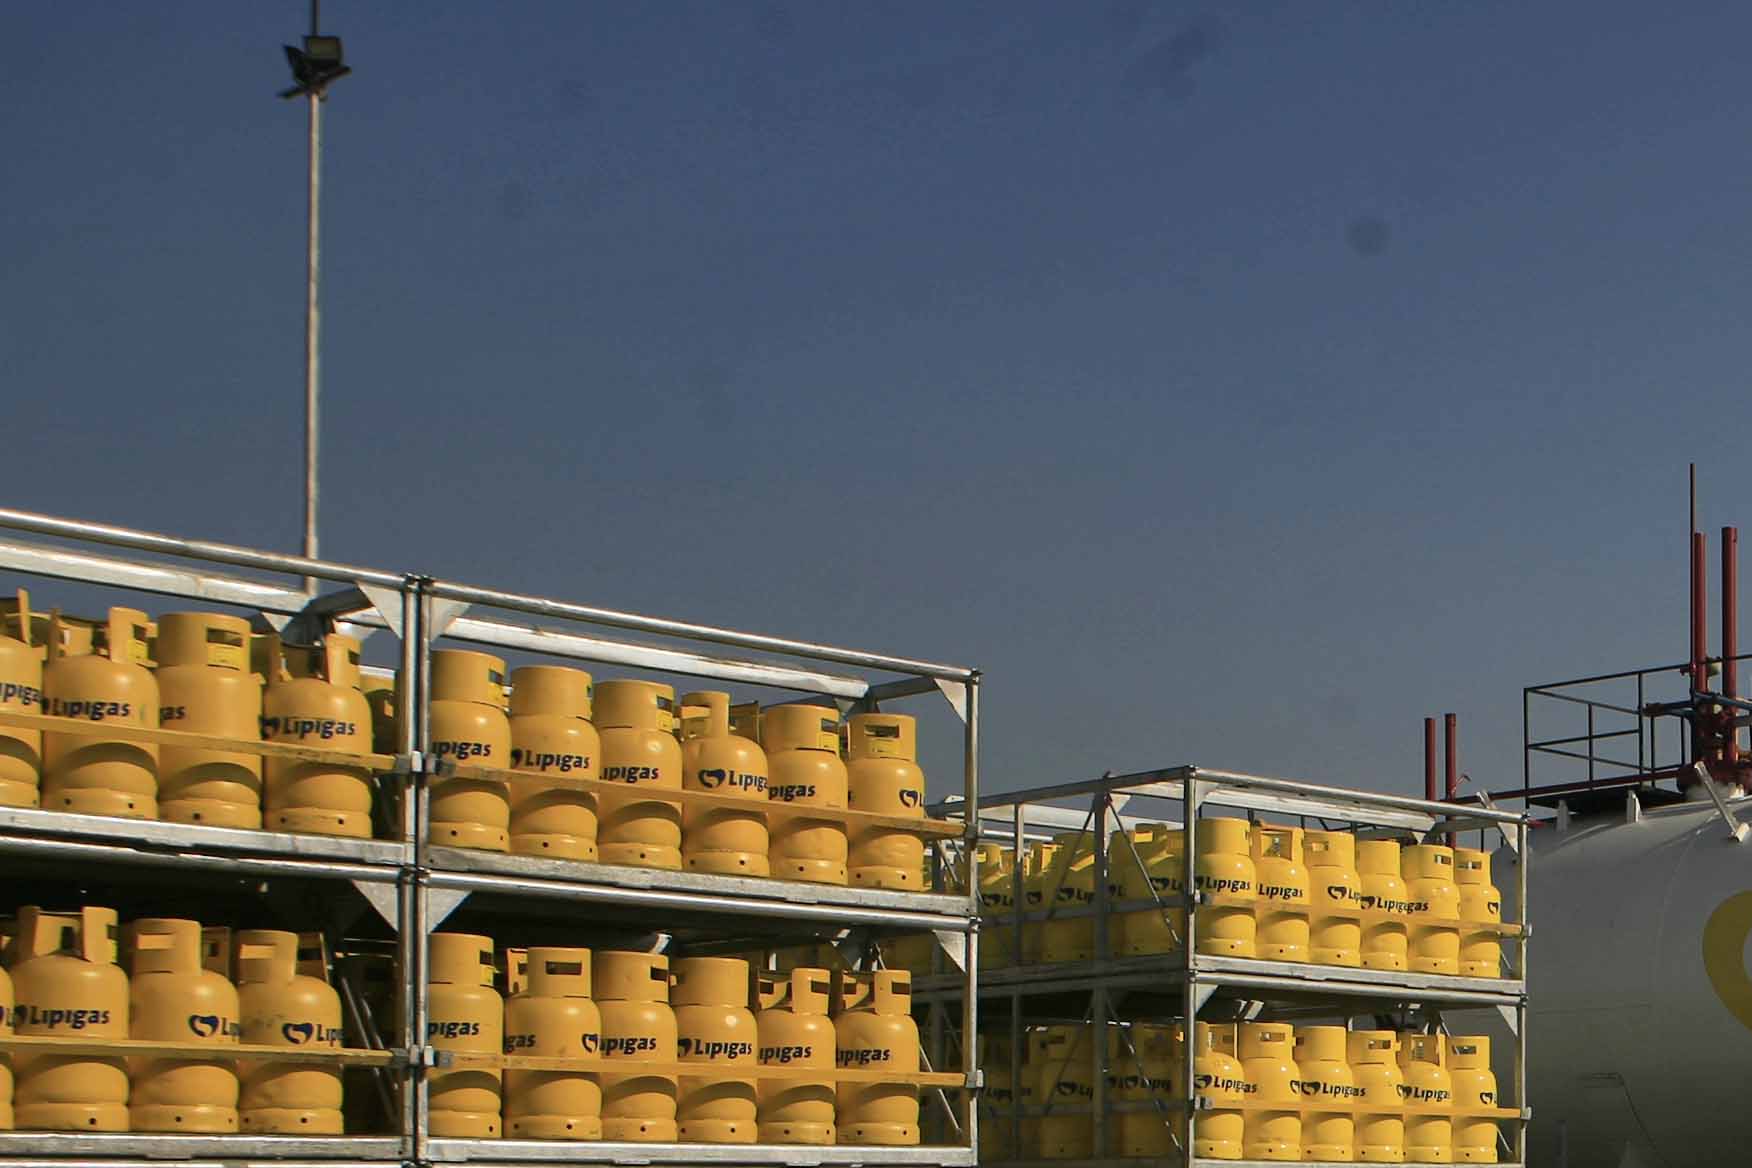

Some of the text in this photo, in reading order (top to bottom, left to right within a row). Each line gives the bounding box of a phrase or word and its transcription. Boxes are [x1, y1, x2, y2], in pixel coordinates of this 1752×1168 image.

[0, 682, 42, 706] piga
[52, 697, 131, 721] Lipigas
[285, 717, 355, 740] Lipigas
[432, 741, 491, 760] ipigas
[525, 750, 590, 772] Lipigas
[600, 767, 659, 783] ipigas
[769, 784, 815, 801] pigas
[31, 1006, 109, 1029] Lipigas
[428, 1022, 479, 1038] pigas
[600, 1036, 656, 1054] ipigas
[694, 1039, 751, 1059] Lipigas
[760, 1044, 811, 1063] ipigas
[836, 1048, 890, 1064] ipigas
